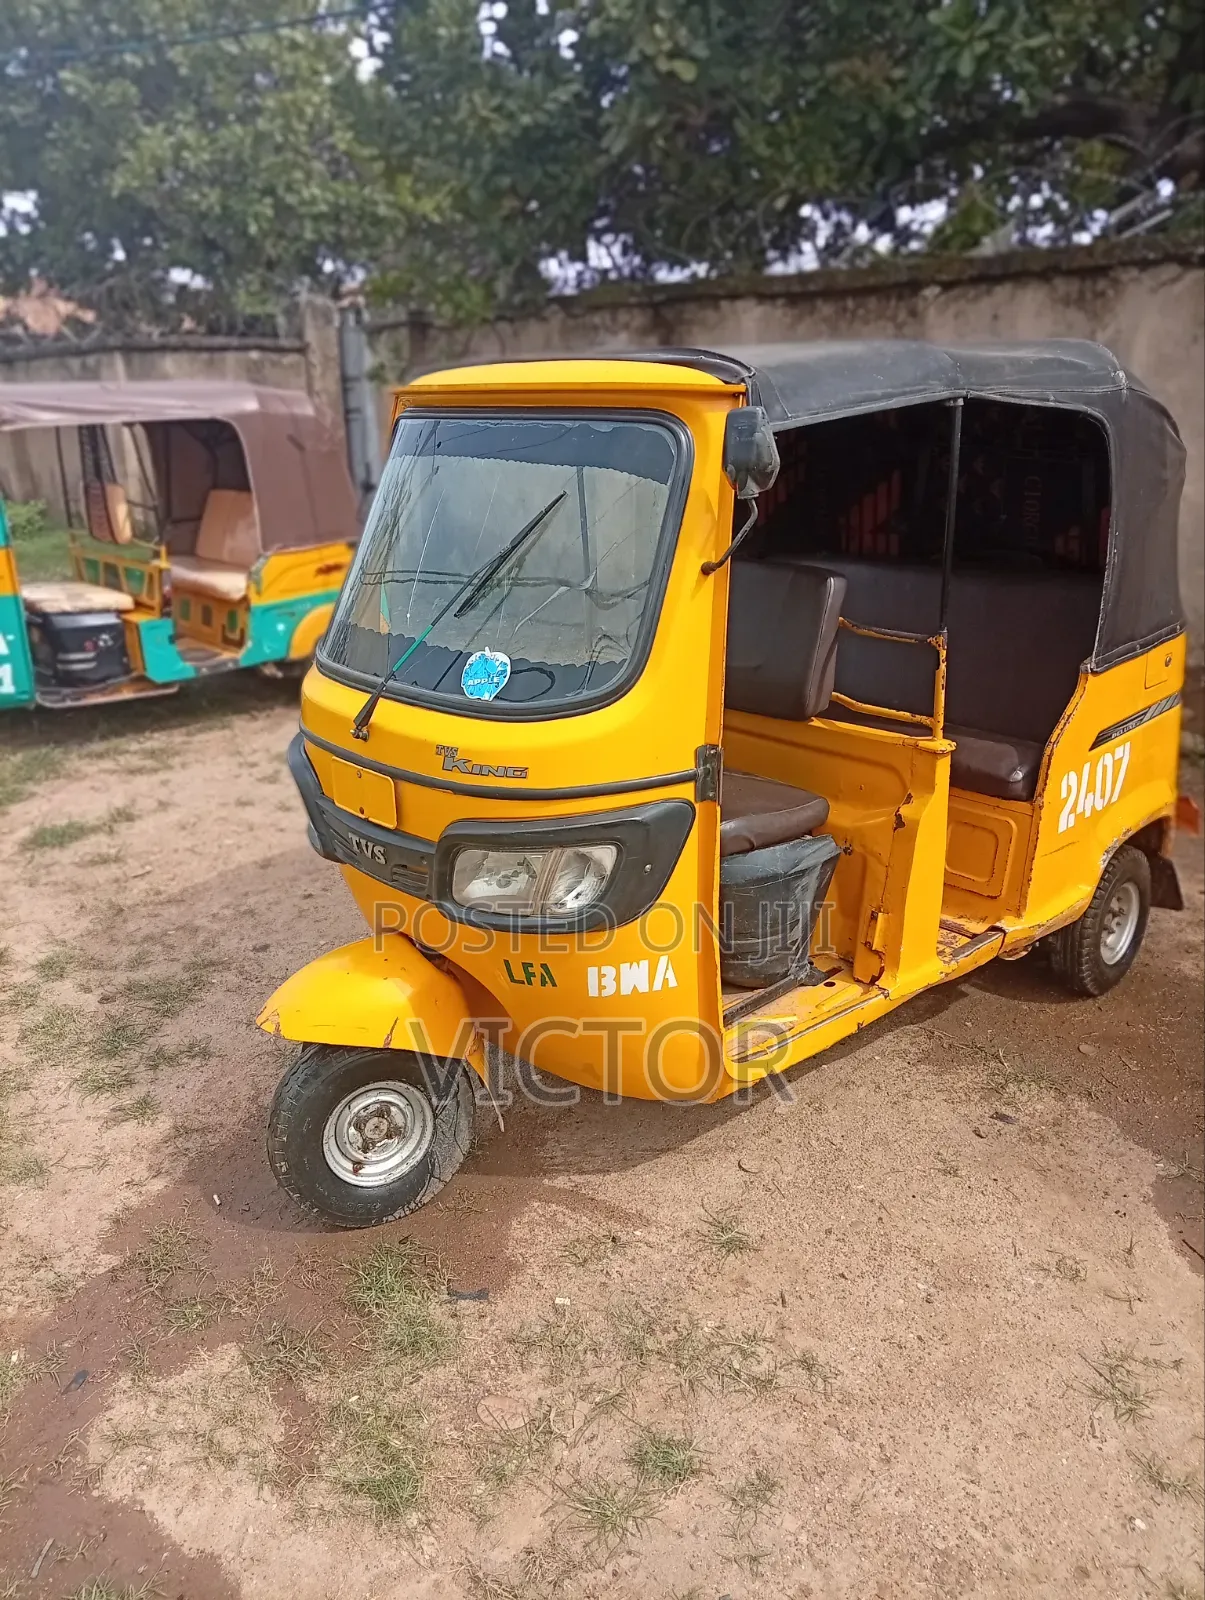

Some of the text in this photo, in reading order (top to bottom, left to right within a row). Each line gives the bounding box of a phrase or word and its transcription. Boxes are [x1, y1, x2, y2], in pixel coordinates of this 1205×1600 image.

[467, 676, 500, 686] APPLE
[436, 744, 459, 757] TVS
[442, 756, 529, 778] KING
[1057, 740, 1131, 834] 2407
[348, 832, 387, 865] TVS
[503, 958, 558, 988] LFA
[587, 954, 678, 998] BWA
